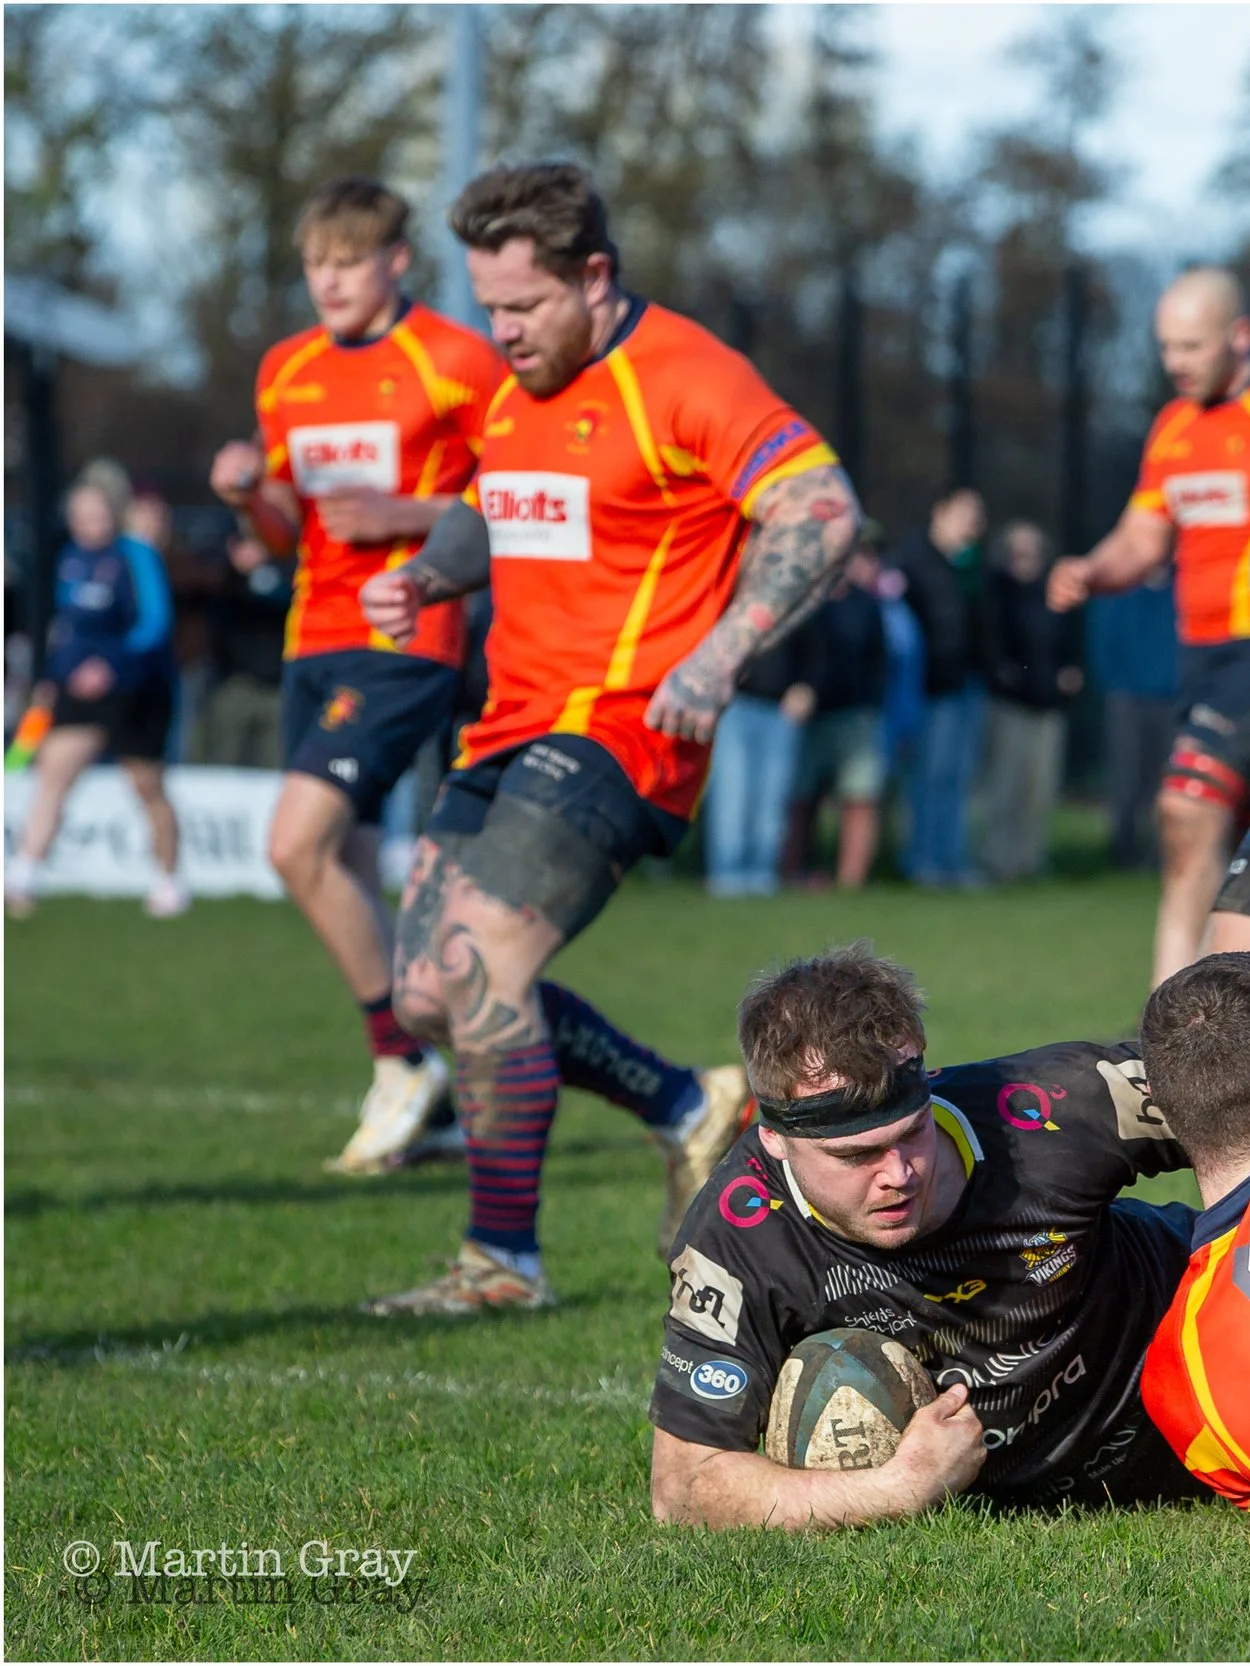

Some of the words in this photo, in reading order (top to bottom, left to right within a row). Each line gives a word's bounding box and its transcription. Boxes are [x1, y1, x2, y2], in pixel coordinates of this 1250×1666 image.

[1029, 1244, 1076, 1285] VIKINGS
[661, 1345, 693, 1374] ncept
[698, 1364, 740, 1393] 360
[981, 1353, 1088, 1450] ompra
